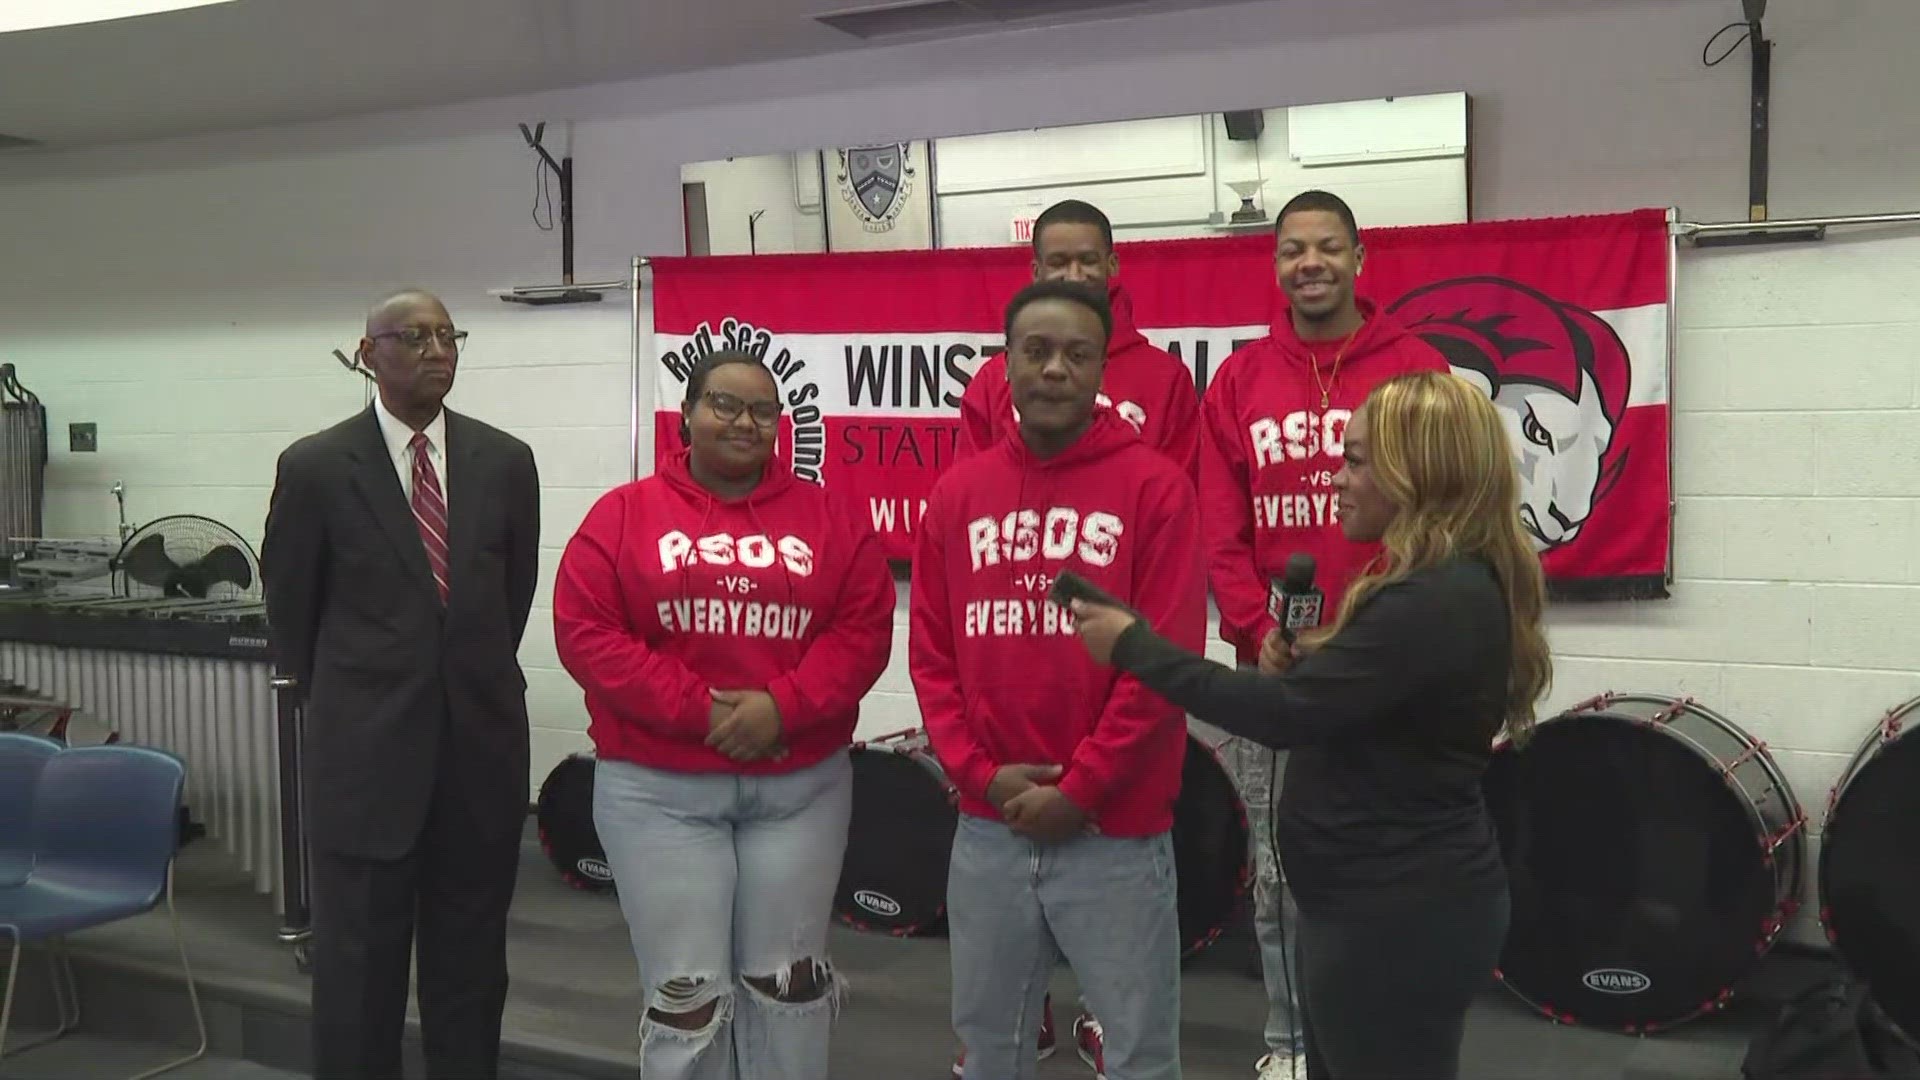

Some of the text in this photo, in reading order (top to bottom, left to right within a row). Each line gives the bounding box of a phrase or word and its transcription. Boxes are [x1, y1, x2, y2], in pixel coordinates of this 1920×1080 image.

[661, 325, 714, 383] Red
[723, 320, 771, 360] Sea
[772, 347, 805, 384] of
[1249, 409, 1352, 470] RSO
[658, 529, 813, 577] RSOS
[968, 507, 1124, 573] RSOS
[657, 598, 813, 640] EVERYBODY
[965, 599, 1076, 637] EVERYBO
[859, 893, 895, 912] EVANS
[1590, 973, 1642, 988] EVANS
